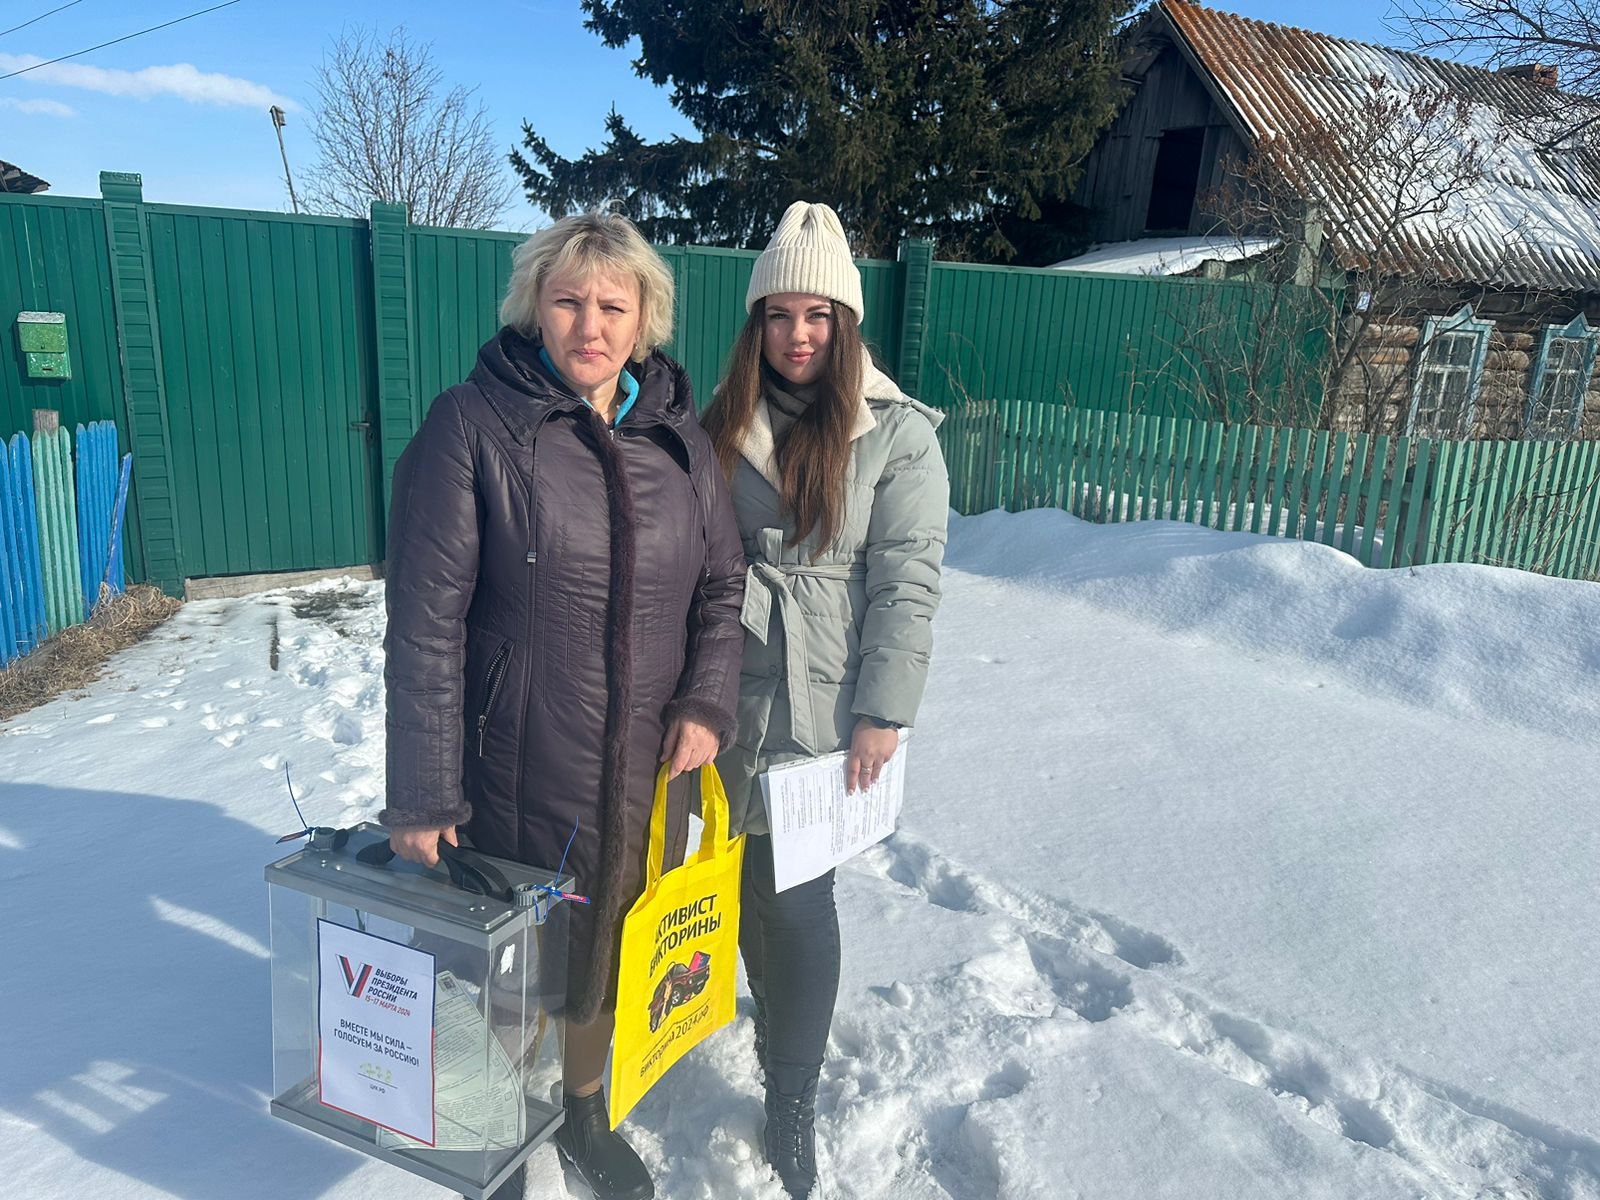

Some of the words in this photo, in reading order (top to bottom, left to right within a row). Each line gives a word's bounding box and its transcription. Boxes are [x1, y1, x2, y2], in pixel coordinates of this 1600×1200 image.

[655, 894, 718, 944] КТИВИСТ
[371, 977, 418, 1000] ПРЕЗИДЕНТА
[375, 968, 409, 986] ВЫБОРЫ
[367, 986, 398, 1003] РОССИИ
[379, 1000, 397, 1013] МАРТА
[397, 1007, 411, 1017] 2024
[340, 1018, 369, 1037] ВМЕСТЕ
[370, 1030, 384, 1043] МЫ
[384, 1035, 406, 1051] СИЛА
[334, 1028, 372, 1050] ГОЛОСУЕМ
[373, 1043, 383, 1054] ЗА
[384, 1047, 420, 1067] РОССИЮ!
